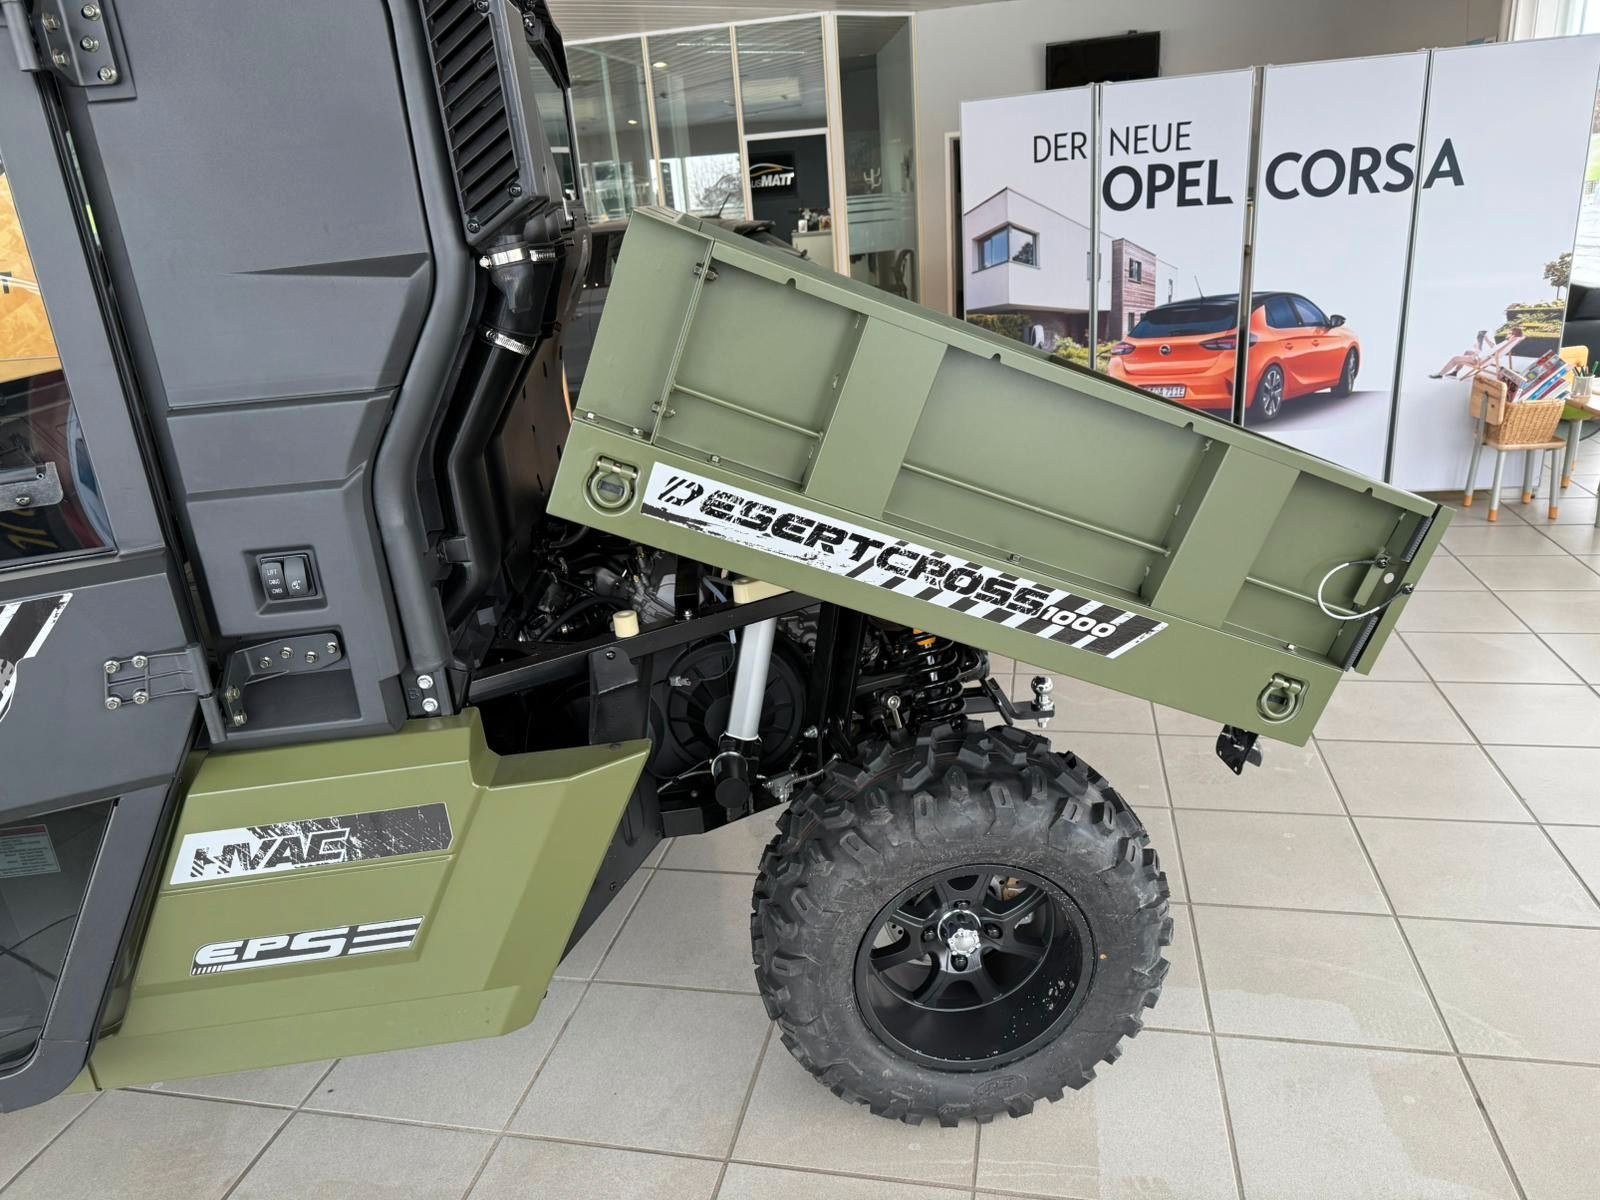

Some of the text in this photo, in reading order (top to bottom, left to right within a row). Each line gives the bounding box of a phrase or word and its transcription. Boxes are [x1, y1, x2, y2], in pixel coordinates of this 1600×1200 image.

[1033, 121, 1192, 163] DER NEUE
[1102, 138, 1465, 211] OPEL CORSA
[1041, 606, 1117, 638] 1000
[195, 927, 349, 965] EPS
